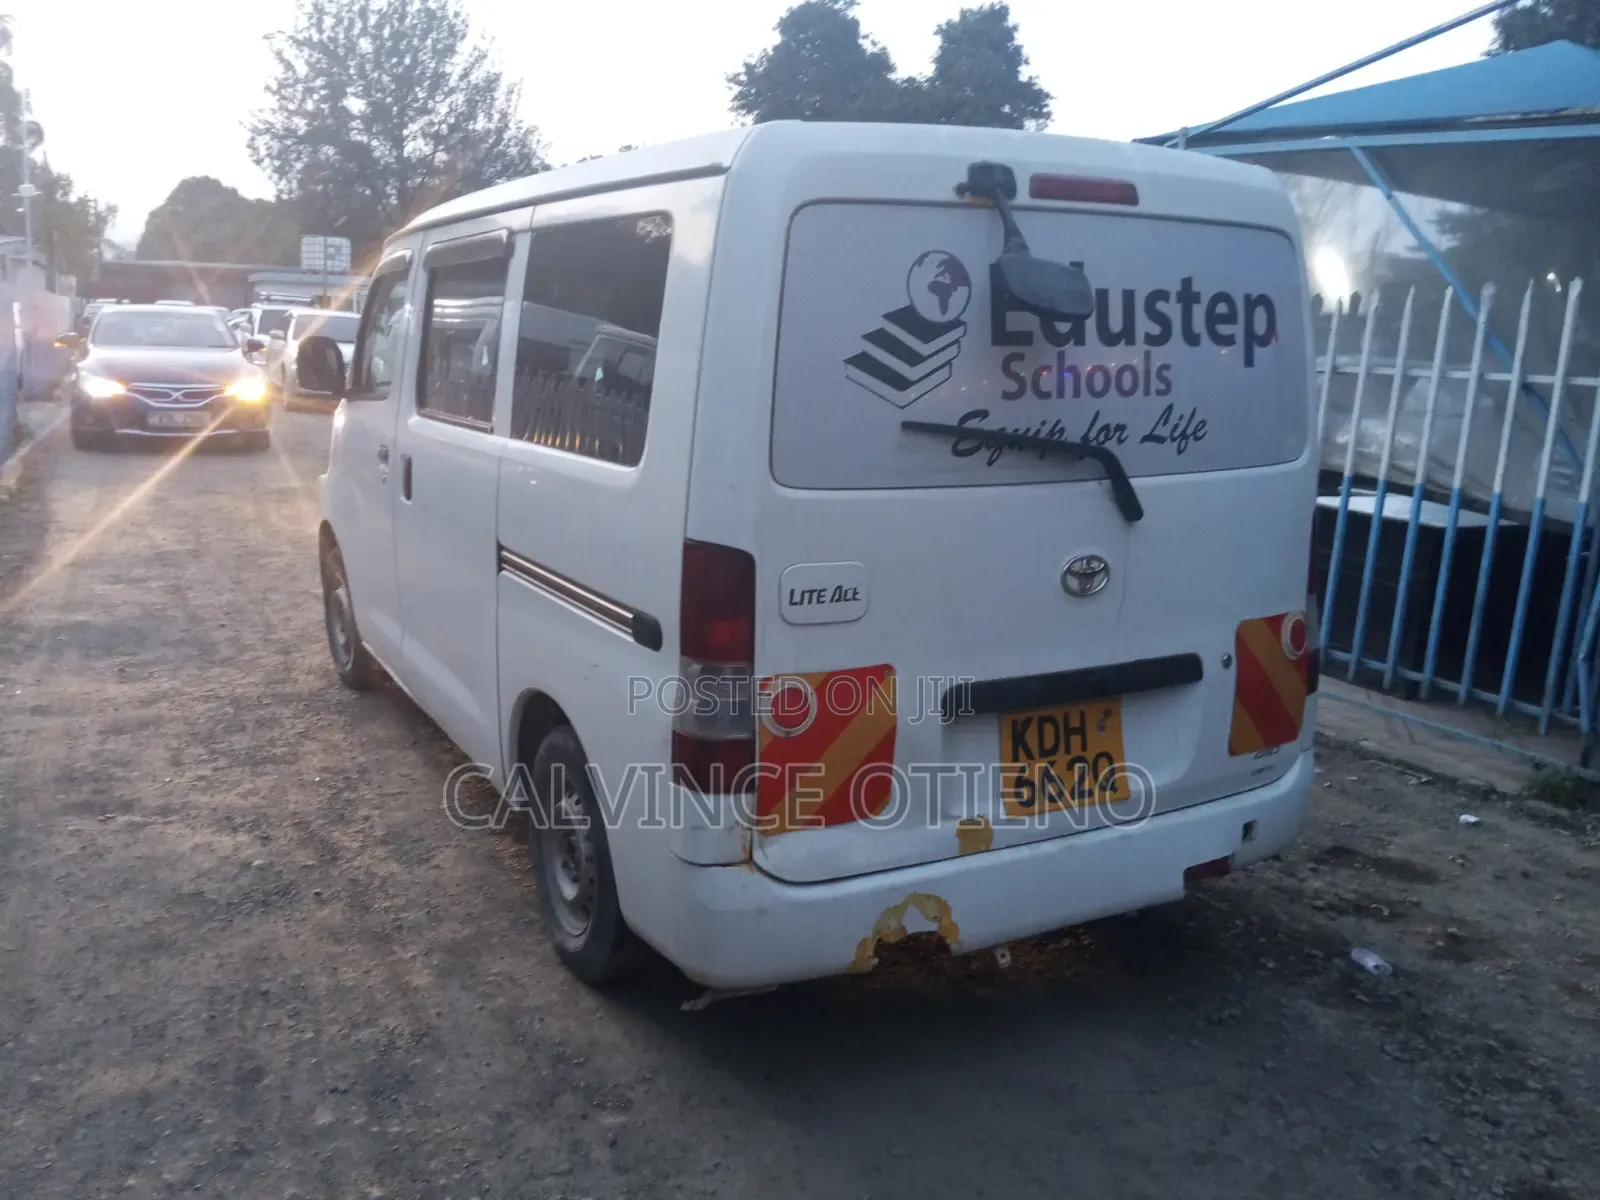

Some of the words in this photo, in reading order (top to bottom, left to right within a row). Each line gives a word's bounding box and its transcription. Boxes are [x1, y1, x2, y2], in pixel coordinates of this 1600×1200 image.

[1000, 350, 1173, 401] Schools
[1139, 402, 1208, 456] Life
[788, 588, 827, 606] LITE
[1010, 710, 1088, 763] KDH
